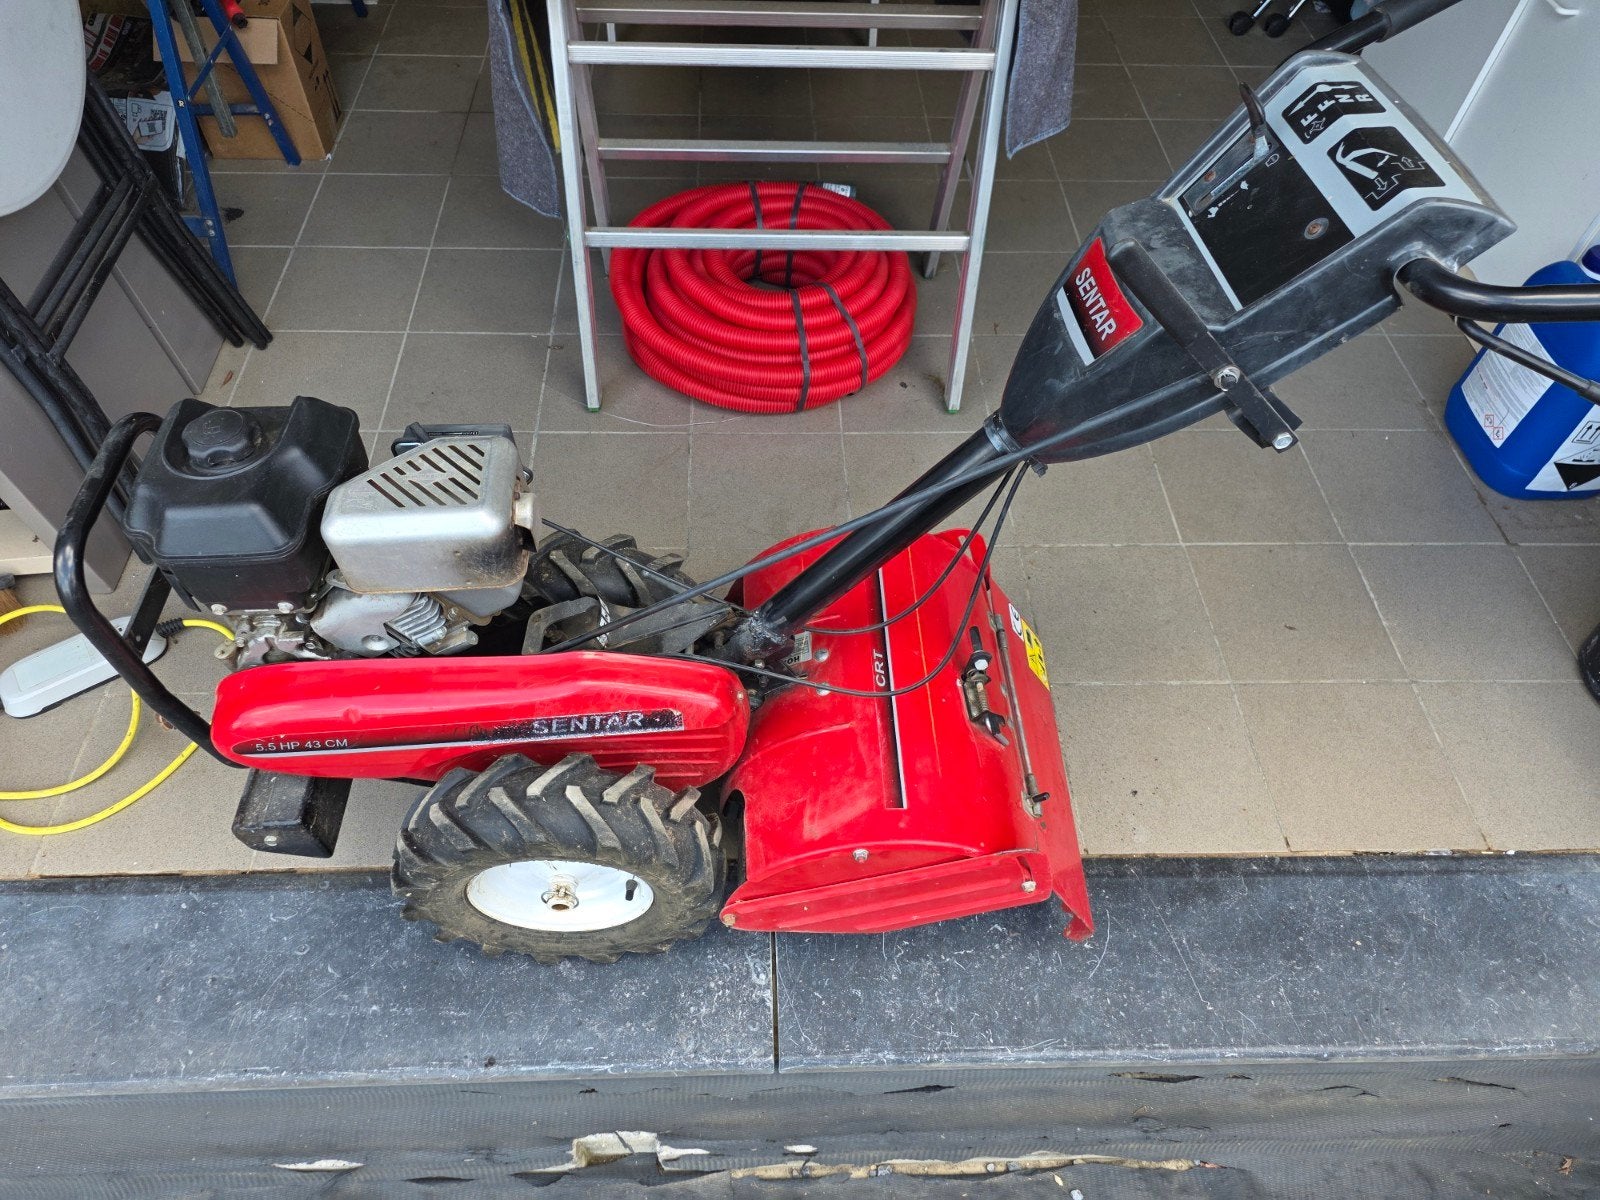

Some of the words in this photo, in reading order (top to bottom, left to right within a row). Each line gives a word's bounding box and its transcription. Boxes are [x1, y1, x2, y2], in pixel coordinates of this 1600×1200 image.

[1334, 95, 1355, 103] N
[1355, 94, 1373, 102] R
[1317, 99, 1335, 112] F
[1300, 113, 1318, 127] F
[1075, 267, 1117, 341] SENTAR
[873, 648, 886, 687] CRT
[532, 712, 645, 735] SENTAR
[255, 743, 277, 752] 5.5
[280, 741, 300, 751] HP
[304, 740, 321, 749] 43
[325, 738, 348, 748] CM
